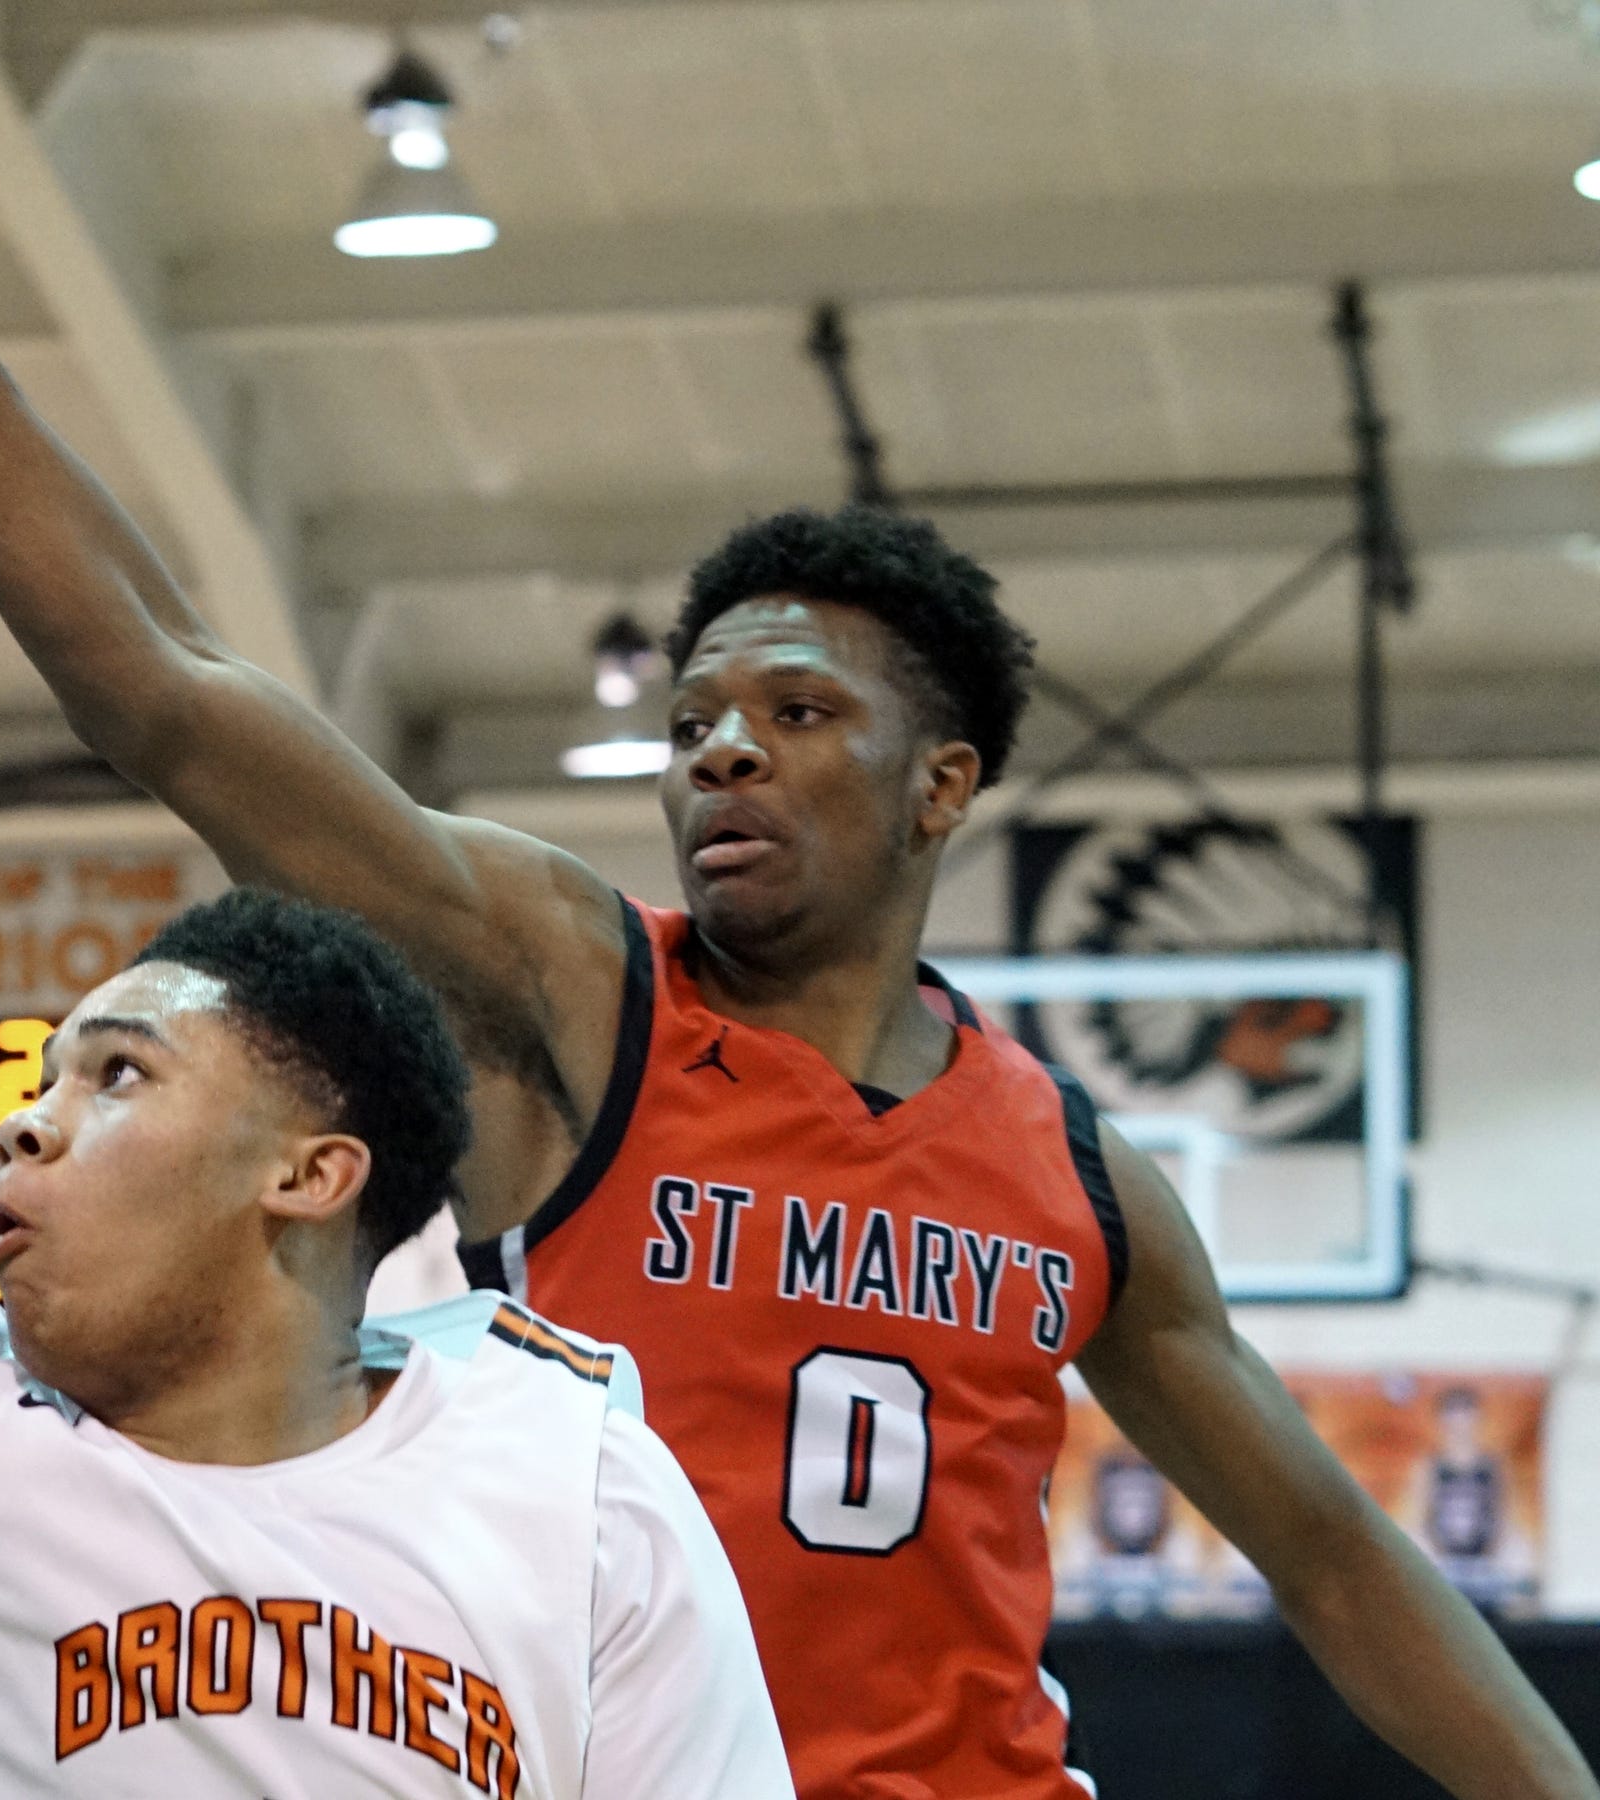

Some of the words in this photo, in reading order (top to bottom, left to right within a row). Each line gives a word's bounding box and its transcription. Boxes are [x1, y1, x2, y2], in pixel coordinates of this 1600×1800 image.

[643, 1174, 754, 1290] ST
[778, 1195, 1075, 1354] MARY'S
[781, 1345, 933, 1558] 0
[54, 1595, 520, 1800] BROTHER
